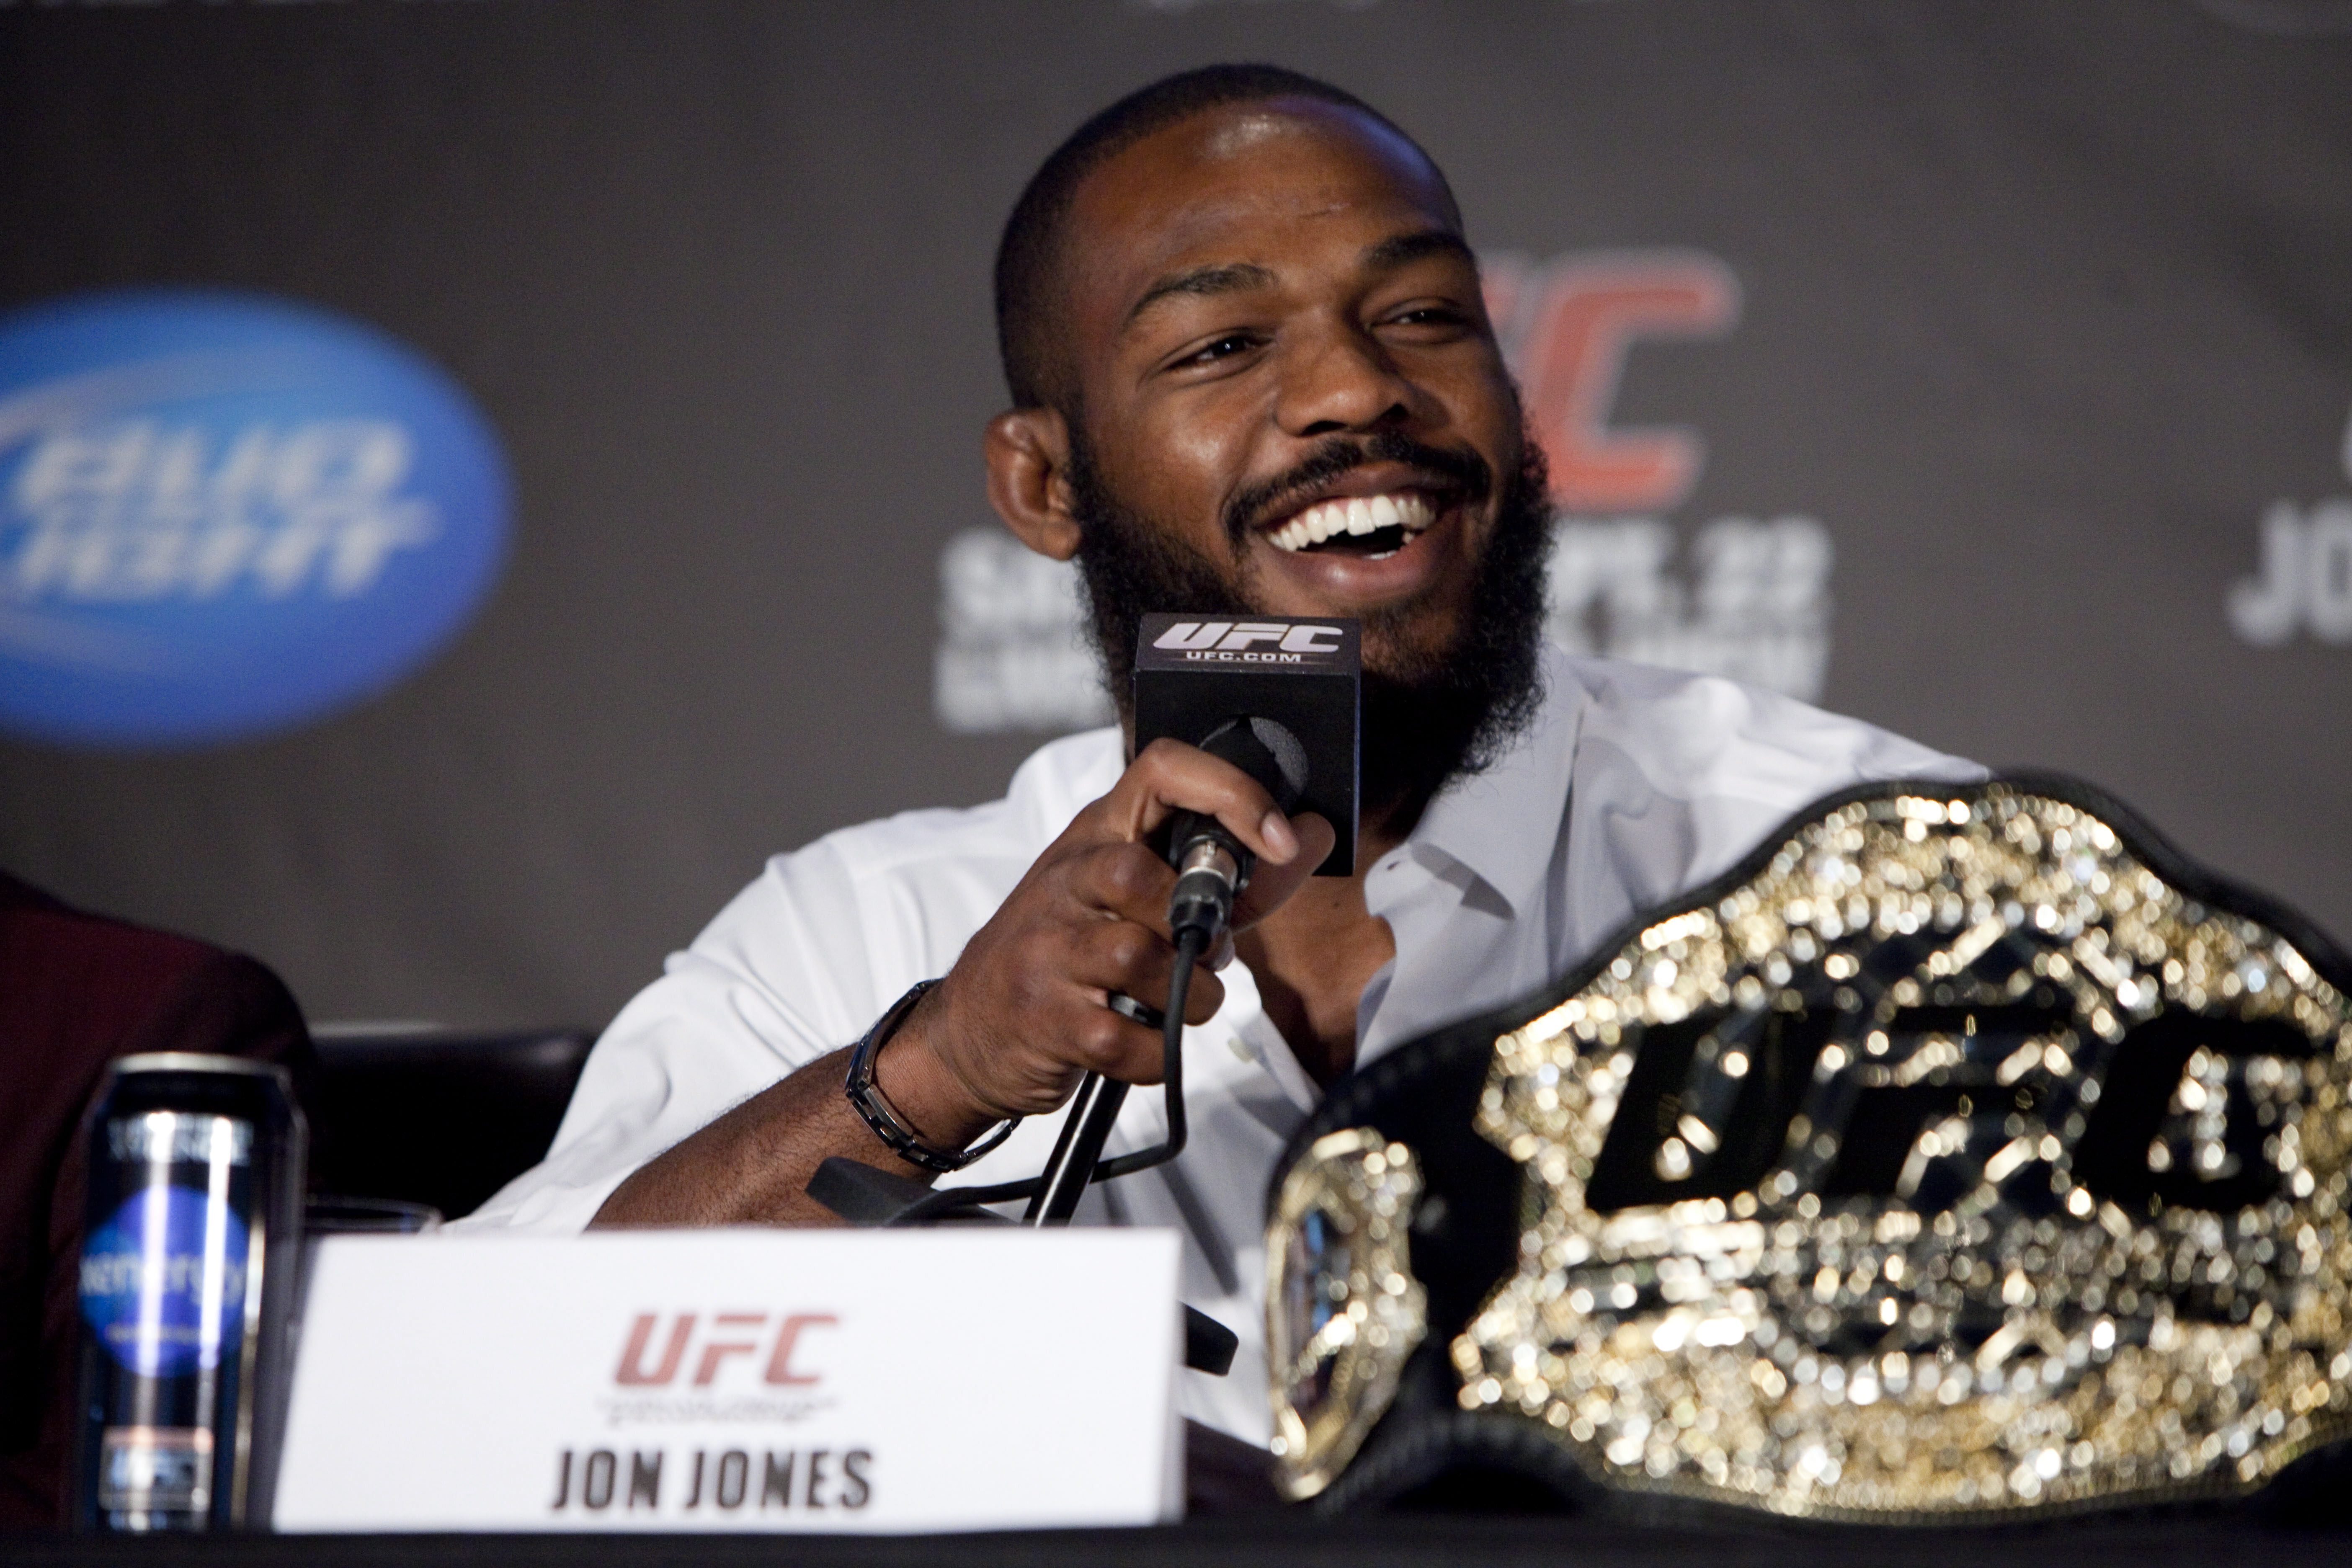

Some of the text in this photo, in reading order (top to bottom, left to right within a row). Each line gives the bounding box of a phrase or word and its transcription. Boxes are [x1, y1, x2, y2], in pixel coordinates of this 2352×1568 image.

[1153, 622, 1343, 652] UFC
[1186, 651, 1301, 663] UFC.COM
[613, 1313, 841, 1386] UFC
[550, 1448, 873, 1510] JON JONES
